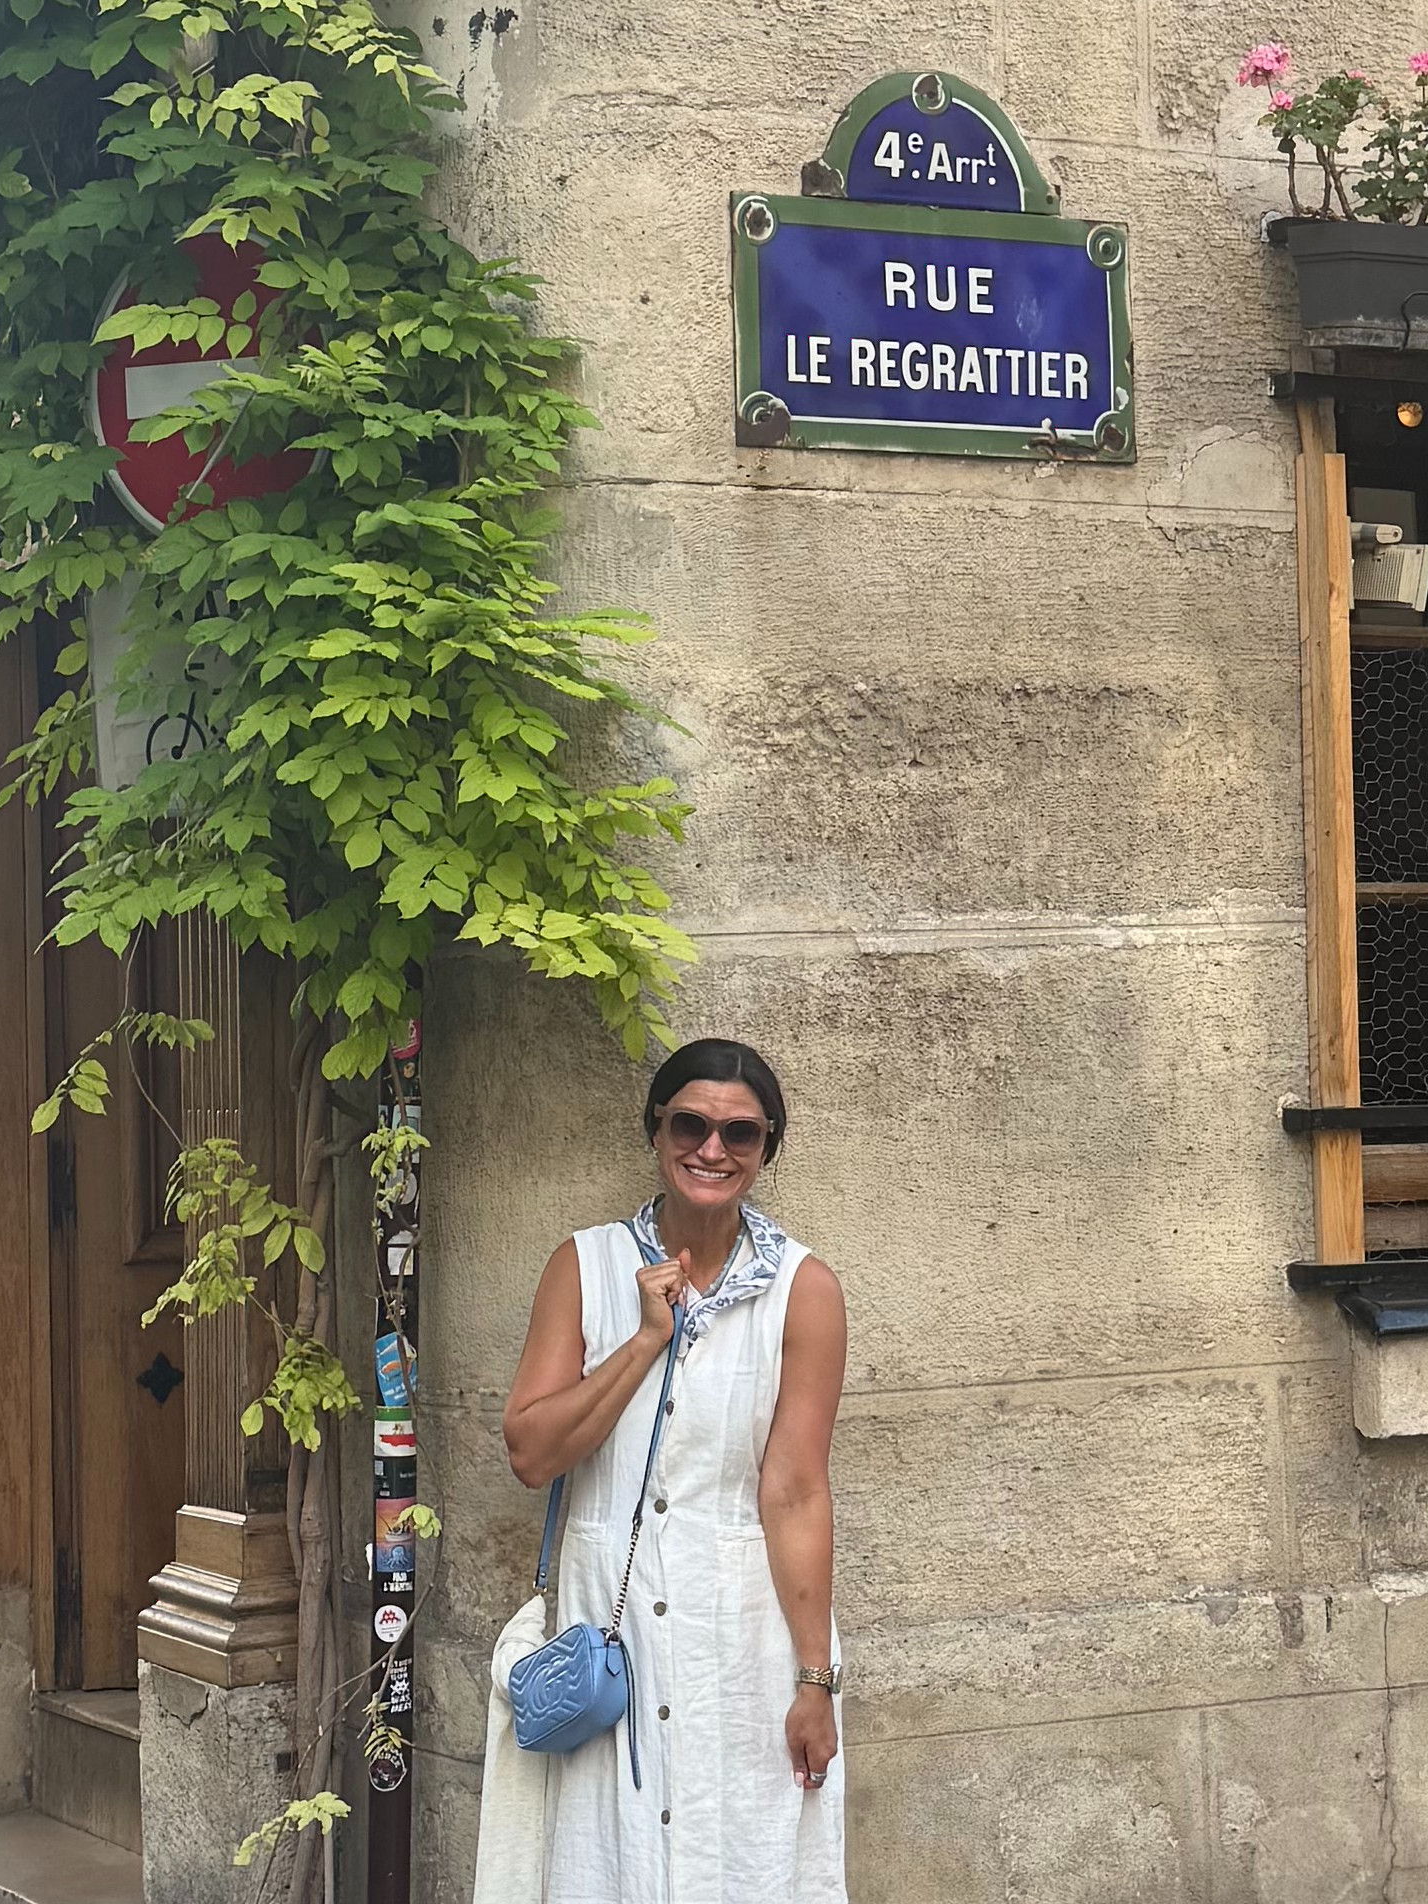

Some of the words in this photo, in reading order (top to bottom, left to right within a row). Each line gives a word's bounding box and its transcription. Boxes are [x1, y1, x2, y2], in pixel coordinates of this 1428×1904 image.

[883, 260, 995, 315] RUE
[786, 334, 832, 385] LE
[850, 337, 1089, 401] REGRATTIER
